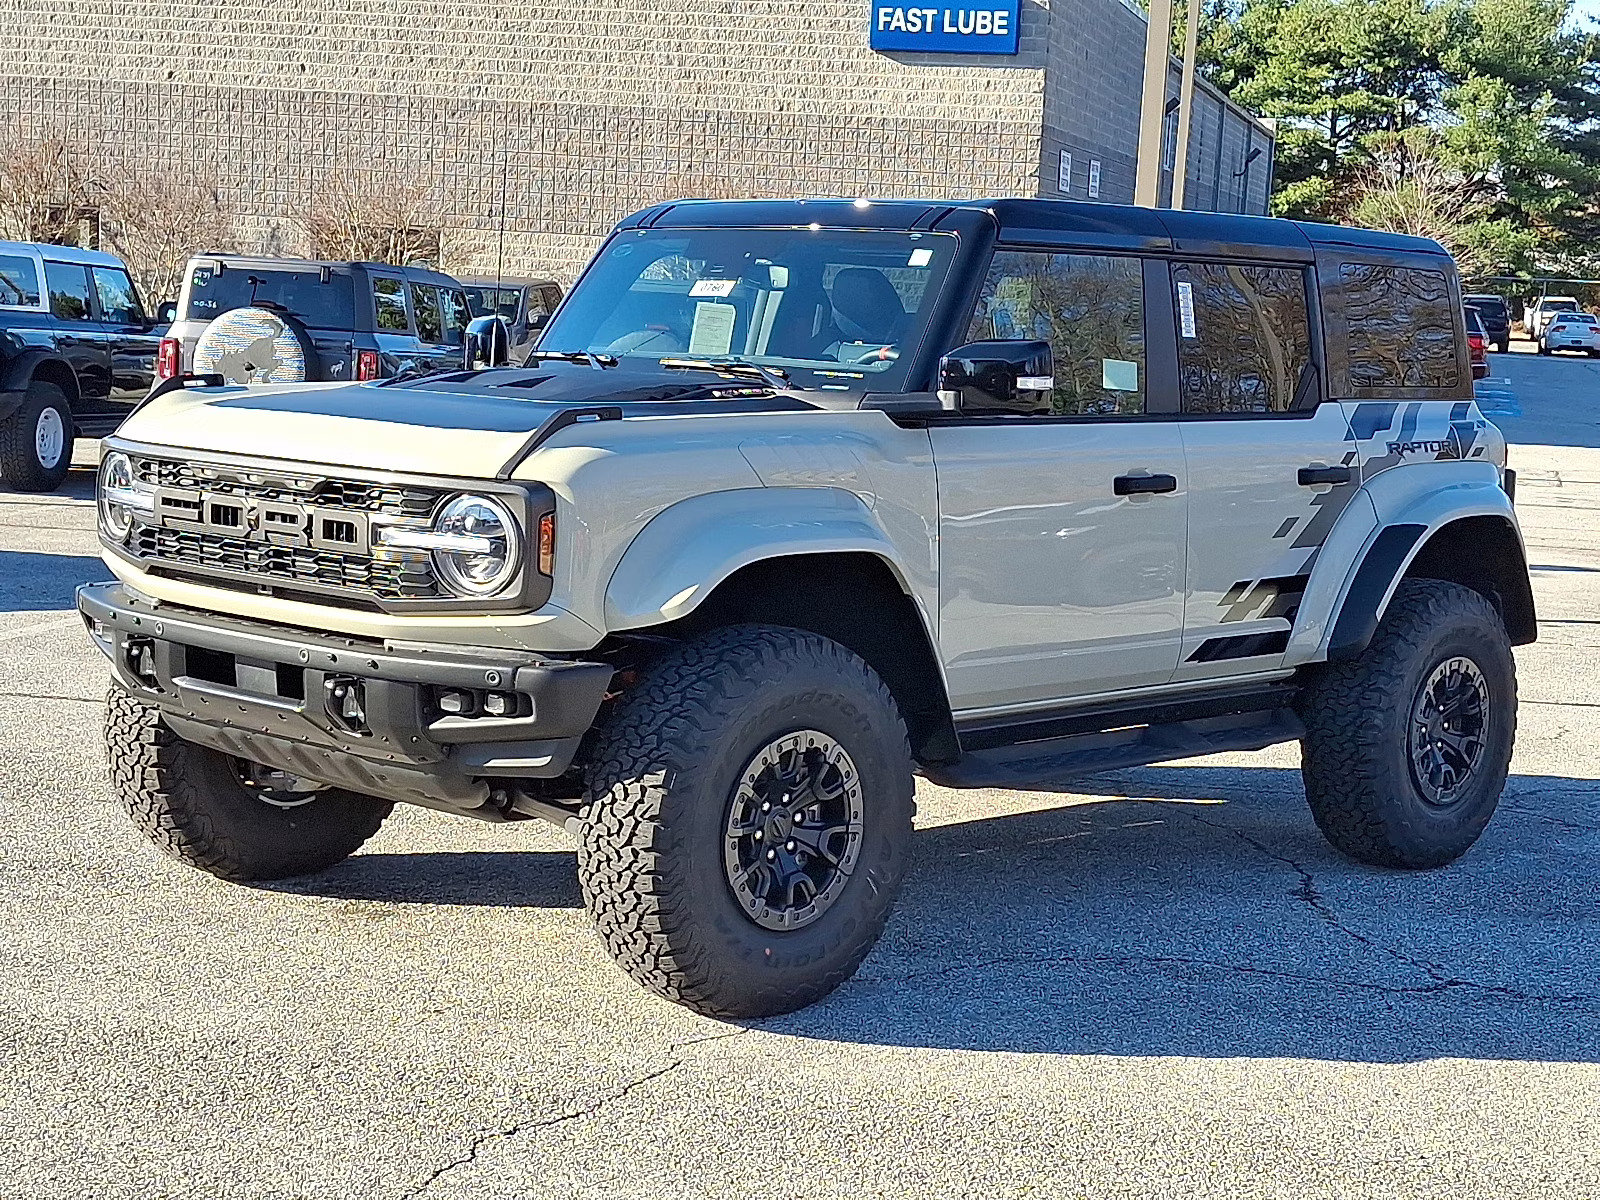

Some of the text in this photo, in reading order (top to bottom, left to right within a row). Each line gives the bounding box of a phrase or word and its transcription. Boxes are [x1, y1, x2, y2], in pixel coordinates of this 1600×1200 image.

[878, 7, 1009, 35] FAST LUBE
[1386, 440, 1457, 460] RAPTOR
[153, 488, 370, 556] FORD
